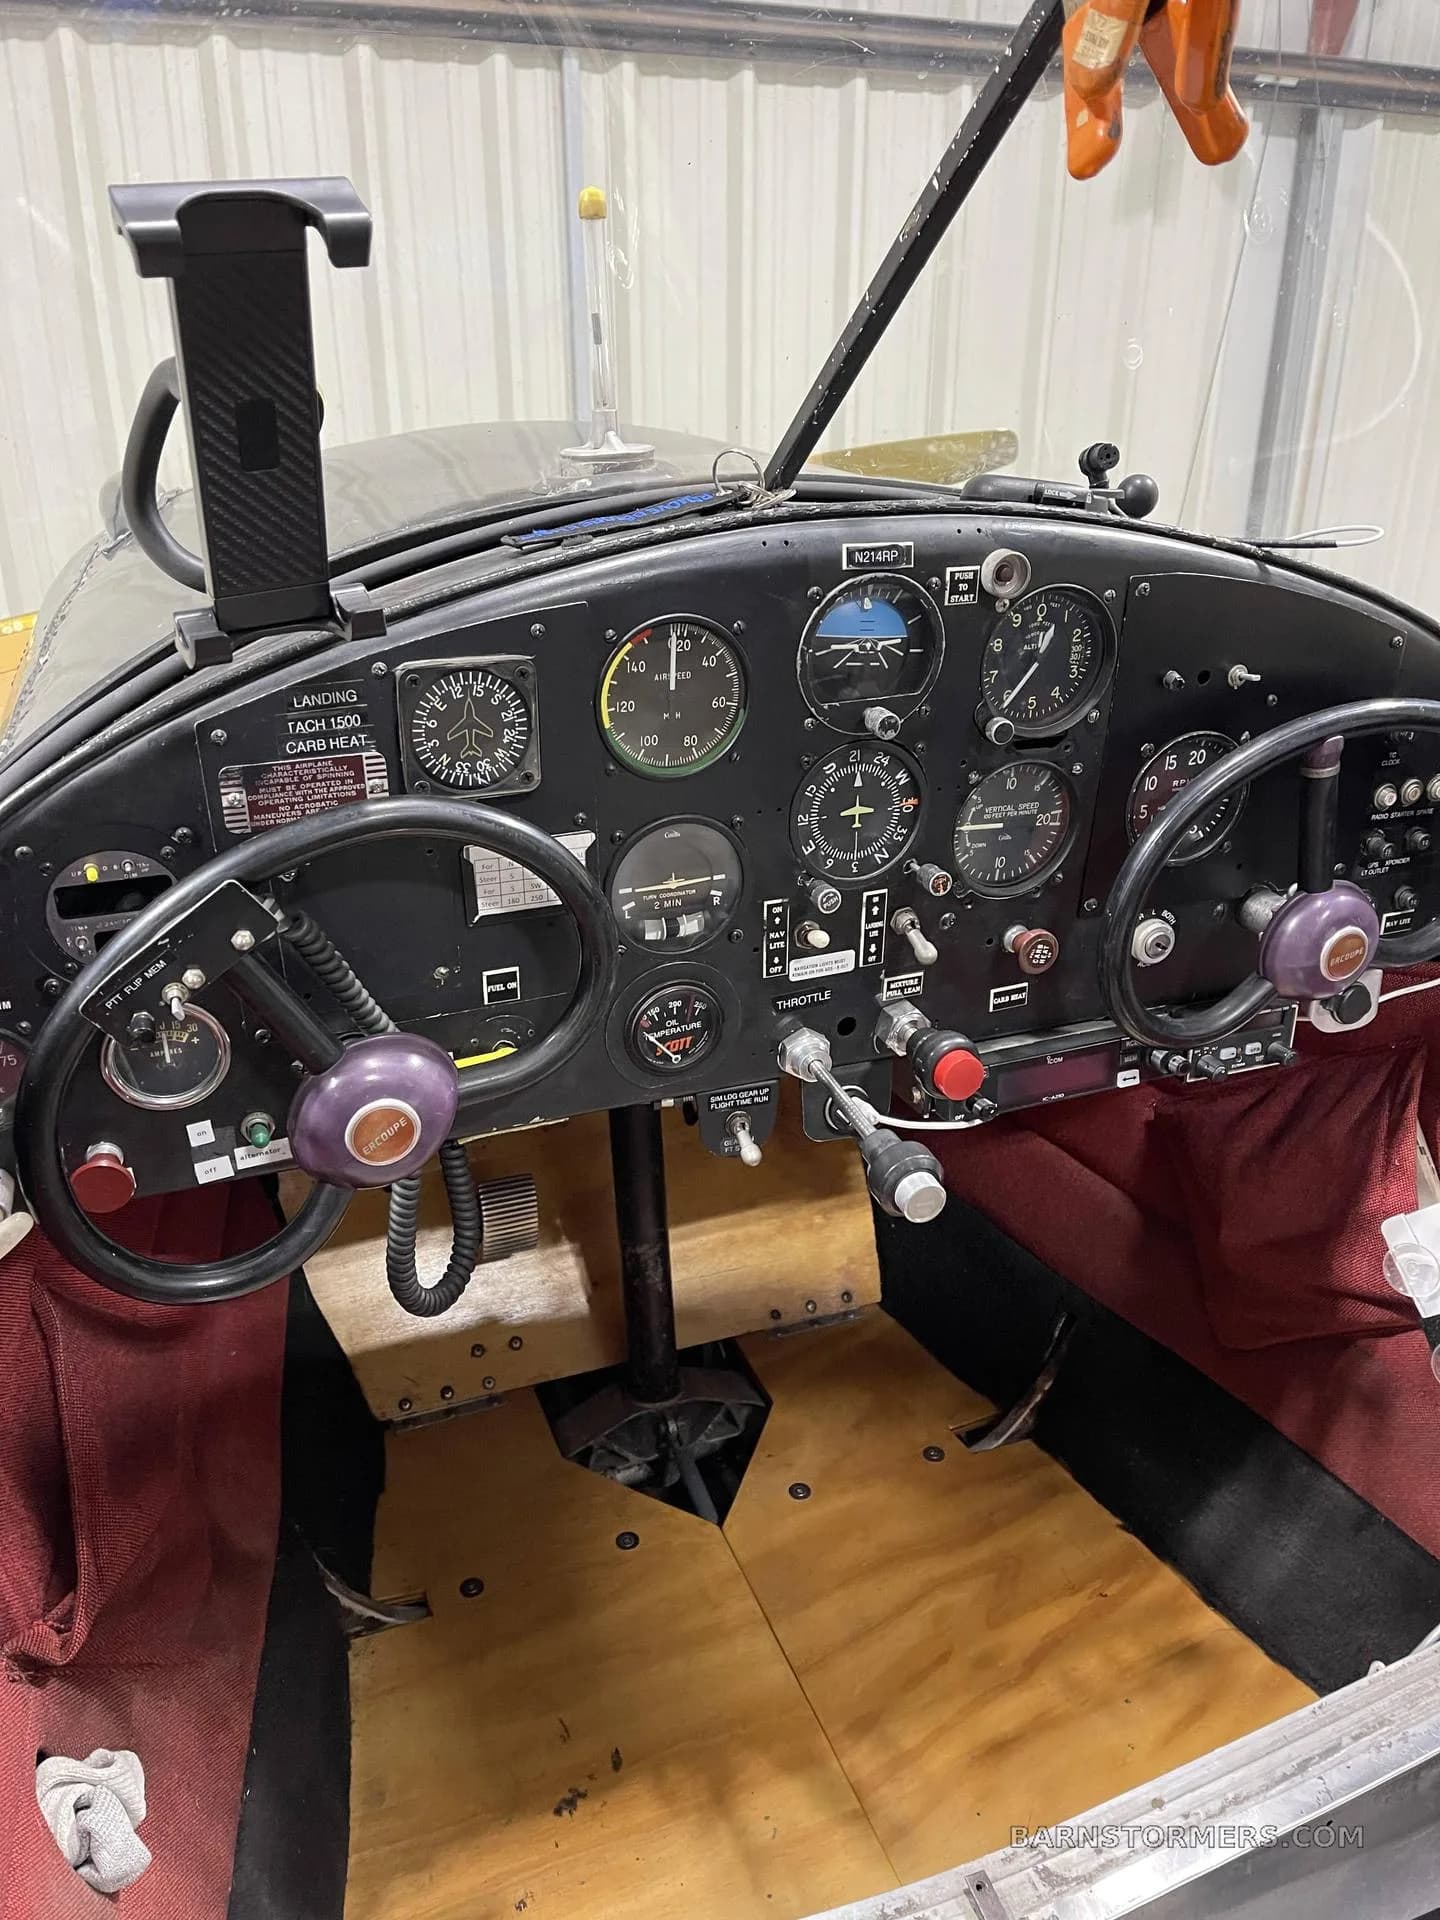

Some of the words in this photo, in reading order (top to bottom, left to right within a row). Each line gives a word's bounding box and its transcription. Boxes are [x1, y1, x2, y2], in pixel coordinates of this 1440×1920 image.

[1044, 488, 1059, 497] LOCK
[854, 549, 899, 563] N214RP
[954, 571, 974, 581] PUSH
[958, 583, 969, 592] TO
[949, 593, 975, 603] START
[1036, 603, 1047, 617] 0
[1064, 609, 1069, 623] 1
[1012, 613, 1022, 627] 9
[1072, 628, 1082, 643] 2
[677, 639, 692, 652] 20
[994, 638, 1003, 652] 8
[627, 660, 647, 673] 140
[702, 655, 717, 668] 40
[988, 670, 999, 684] 7
[1069, 665, 1079, 679] 3
[449, 686, 464, 700] 12
[473, 685, 485, 698] 15
[1050, 686, 1061, 699] 4
[293, 689, 358, 708] LANDING
[434, 697, 448, 712] E
[491, 694, 502, 705] S
[711, 696, 727, 709] 60
[1027, 696, 1037, 710] 5
[616, 700, 636, 713] 120
[501, 710, 515, 722] 21
[287, 718, 326, 734] TACH
[330, 714, 361, 730] 1500
[427, 719, 438, 729] 6
[502, 728, 518, 744] 24
[640, 734, 659, 747] 100
[683, 734, 698, 747] 80
[286, 738, 327, 754] CARB
[329, 734, 368, 750] HEAT
[427, 738, 440, 749] 3
[437, 753, 451, 767] N
[494, 748, 510, 762] W
[849, 749, 861, 763] 21
[873, 752, 890, 767] 24
[1188, 749, 1207, 766] 20
[272, 765, 292, 773] THIS
[295, 760, 334, 770] AIRPLANE
[455, 761, 472, 775] 33
[476, 758, 492, 773] 30
[1164, 754, 1177, 771] 15
[1381, 759, 1401, 767] CLOCK
[255, 775, 299, 786] INCAPABLE
[317, 770, 355, 780] SPINNING
[261, 765, 348, 780] CHARACTERISTICALLY
[895, 768, 911, 786] W
[259, 786, 282, 794] MUST
[300, 779, 341, 790] OPERATED
[1006, 777, 1018, 790] 10
[1033, 784, 1041, 792] 15
[1144, 775, 1158, 791] 10
[247, 790, 294, 802] COMPLIANCE
[295, 789, 313, 797] WITH
[329, 783, 366, 793] APPROVED
[804, 784, 817, 797] 15
[258, 795, 304, 807] OPERATING
[307, 790, 357, 801] LIMITATIONS
[294, 800, 339, 810] ACROBATIC
[985, 804, 1016, 814] VERTICAL
[1018, 801, 1040, 811] SPEED
[992, 811, 1006, 819] FEET
[1018, 808, 1038, 816] MINUTE
[1138, 804, 1149, 819] 5
[253, 810, 302, 821] MANEUVERS
[797, 814, 809, 826] 12
[1036, 813, 1051, 826] 20
[1371, 812, 1389, 820] RADIO
[1390, 810, 1414, 819] STARTER
[250, 819, 275, 827] UNDER
[893, 825, 908, 842] 33
[801, 839, 816, 855] E
[873, 847, 890, 864] N
[824, 858, 835, 870] 6
[851, 861, 859, 873] 3
[994, 856, 1006, 869] 10
[1368, 866, 1390, 875] OUTLET
[483, 888, 495, 896] For
[530, 882, 541, 890] SW
[659, 889, 697, 899] COORDINATOR
[531, 894, 544, 902] 250
[654, 901, 661, 910] 2
[664, 898, 682, 909] MIN
[713, 897, 721, 906] R
[823, 896, 839, 909] PUSH
[624, 910, 632, 919] L
[772, 905, 783, 914] ON
[1161, 910, 1177, 925] BOTH
[1385, 919, 1398, 928] NAV
[1399, 917, 1412, 925] LITE
[865, 920, 884, 930] LANDING
[769, 931, 786, 940] NAV
[869, 930, 879, 938] LITE
[769, 941, 785, 950] LITE
[1329, 947, 1365, 967] ERCOUPE
[769, 966, 783, 974] OFF
[104, 993, 123, 1010] PTT
[124, 977, 143, 995] FLIP
[143, 959, 167, 979] MEM
[487, 983, 506, 994] FUEL
[507, 980, 517, 991] ON
[890, 978, 919, 990] MIXTURE
[903, 985, 921, 995] LEAN
[667, 1000, 682, 1009] 200
[776, 990, 832, 1010] THROTTLE
[993, 995, 1010, 1005] CARB
[1010, 992, 1027, 1002] HEAT
[646, 1006, 660, 1017] 150
[694, 1001, 707, 1010] 250
[187, 1022, 199, 1033] 30
[665, 1019, 680, 1028] OIL
[644, 1020, 702, 1041] TEMPERATURE
[710, 1095, 723, 1103] SIM
[723, 1092, 738, 1101] LDG
[738, 1089, 758, 1099] GEAR
[759, 1087, 770, 1096] UP
[710, 1100, 735, 1110] FLIGHT
[736, 1098, 753, 1106] TIME
[753, 1095, 769, 1104] RUN
[362, 1116, 408, 1156] ERCOUPE
[240, 1147, 282, 1161] alternator
[204, 1167, 218, 1175] off
